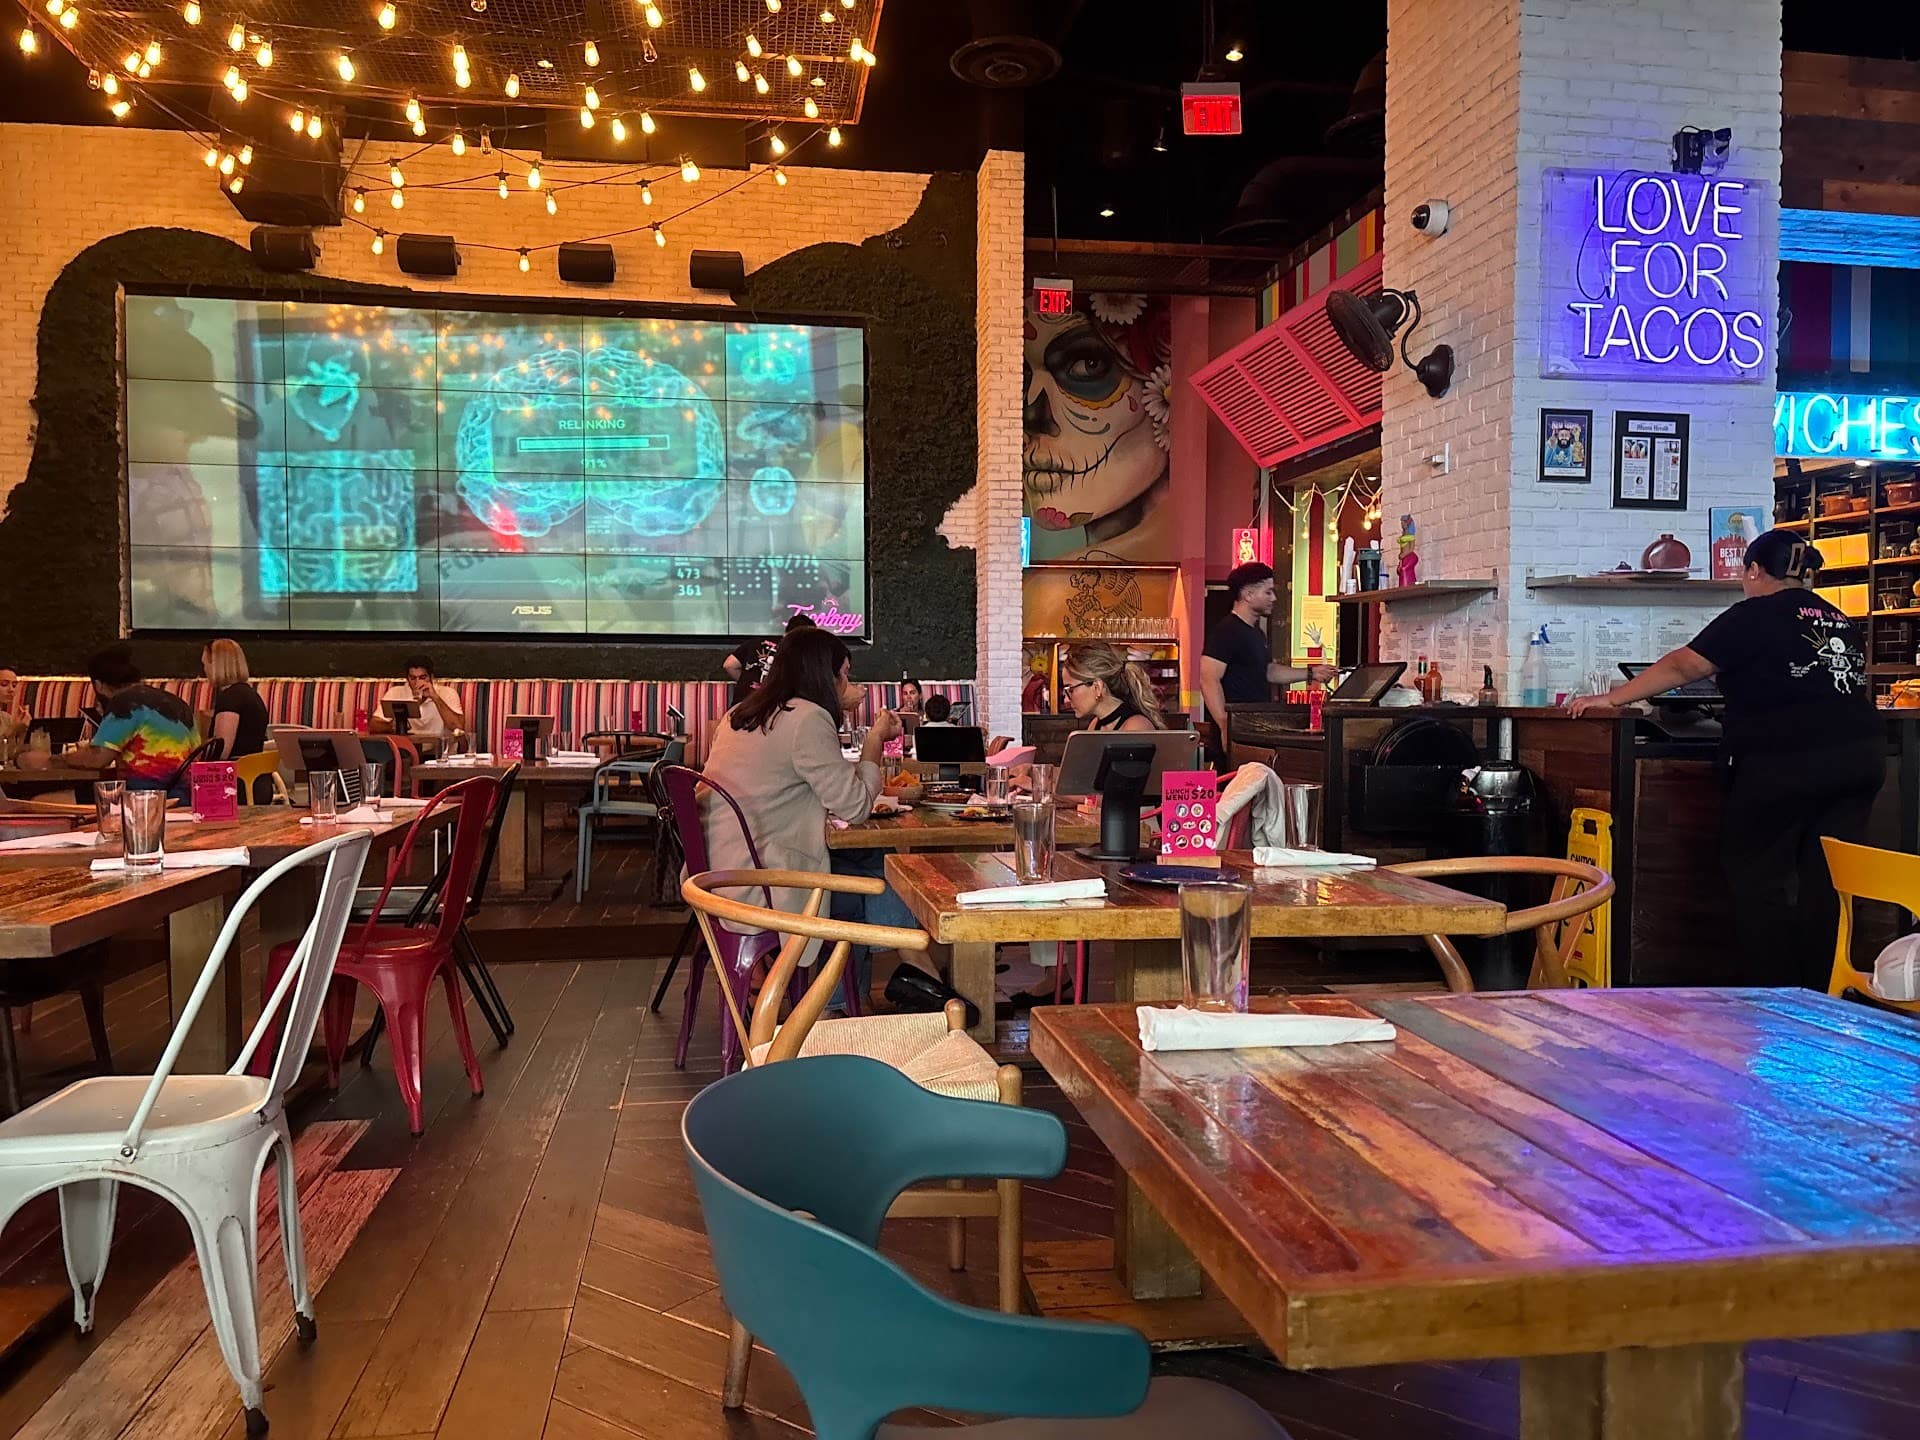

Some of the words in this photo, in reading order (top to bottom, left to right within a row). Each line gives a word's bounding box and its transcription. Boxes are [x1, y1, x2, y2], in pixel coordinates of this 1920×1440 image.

[1596, 174, 1745, 239] LOVE
[1608, 239, 1730, 301] FOR
[1570, 301, 1765, 370] TACOS
[558, 419, 626, 430] RELINKING
[1773, 393, 1920, 456] ICHE
[1720, 547, 1738, 558] BEST
[676, 568, 701, 580] 473
[678, 585, 702, 597] 361
[511, 605, 553, 615] ASUS
[1799, 607, 1823, 618] HOW
